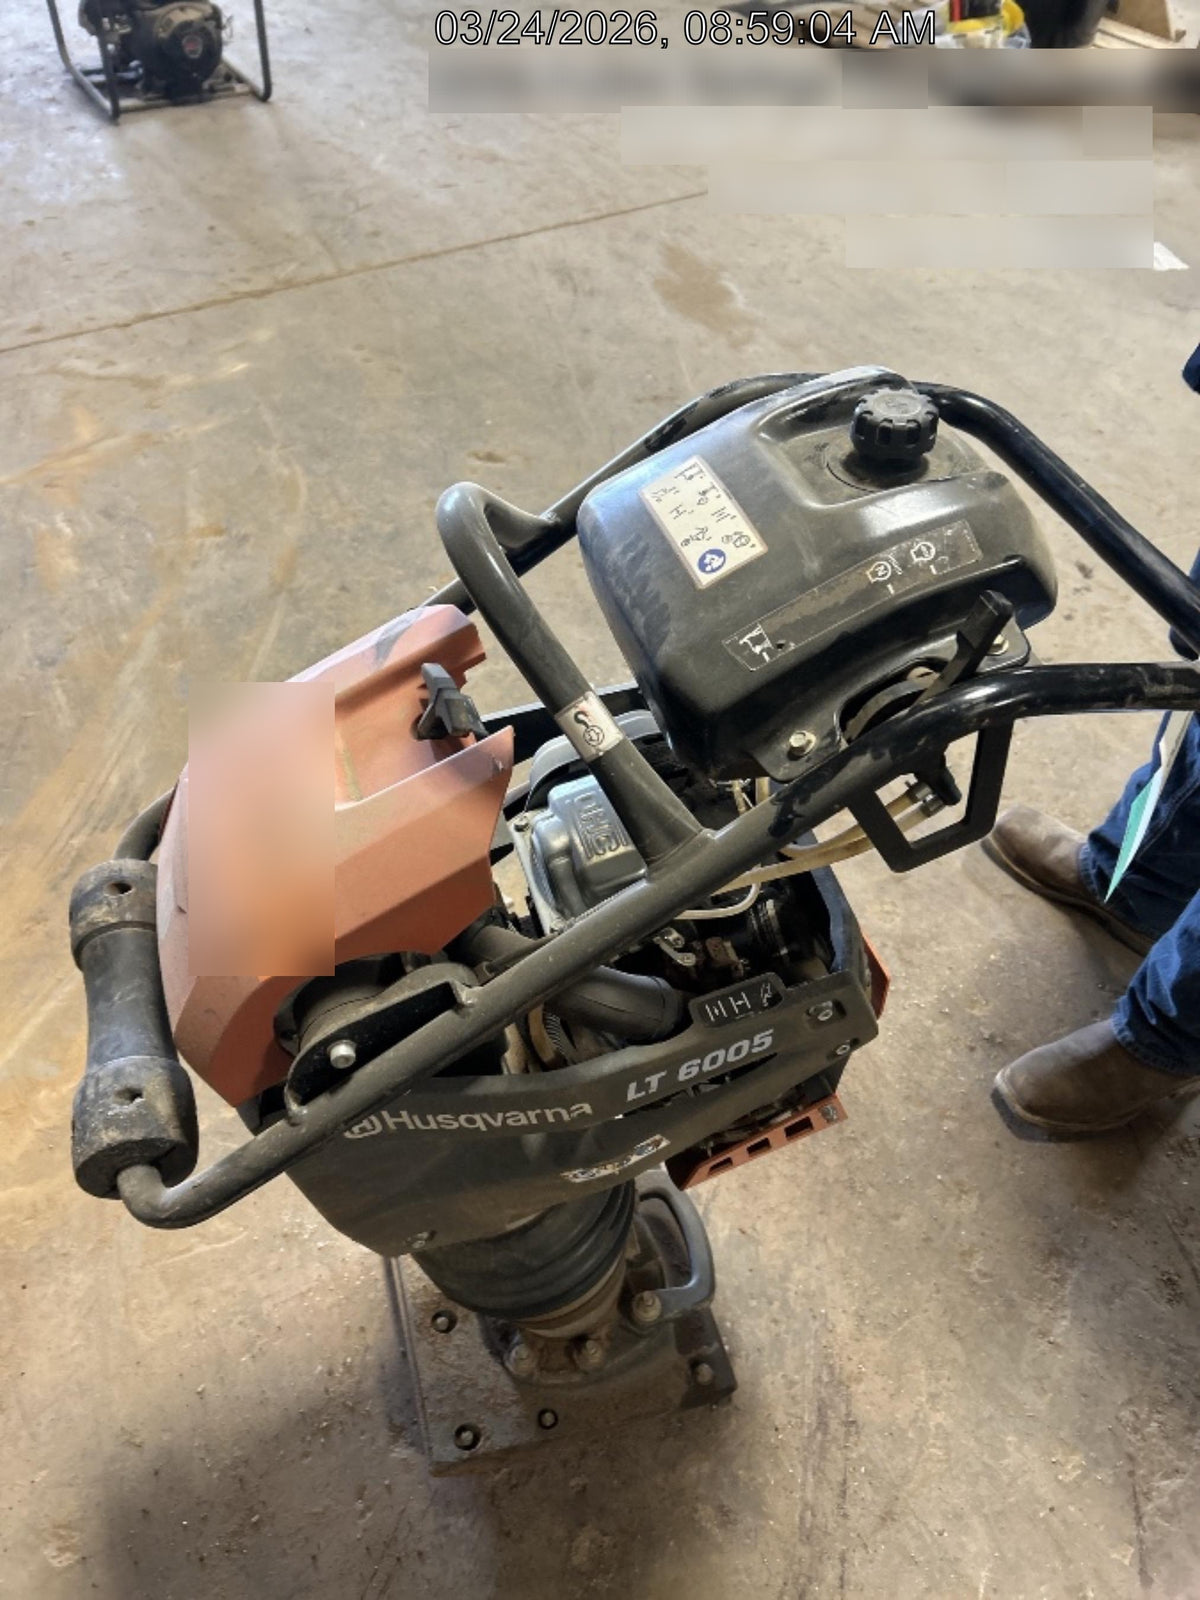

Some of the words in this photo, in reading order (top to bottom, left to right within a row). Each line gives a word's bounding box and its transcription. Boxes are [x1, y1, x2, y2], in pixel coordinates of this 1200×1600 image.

[626, 1070, 668, 1101] LT
[677, 1028, 774, 1082] 6005
[381, 1102, 593, 1132] Husqvarna
